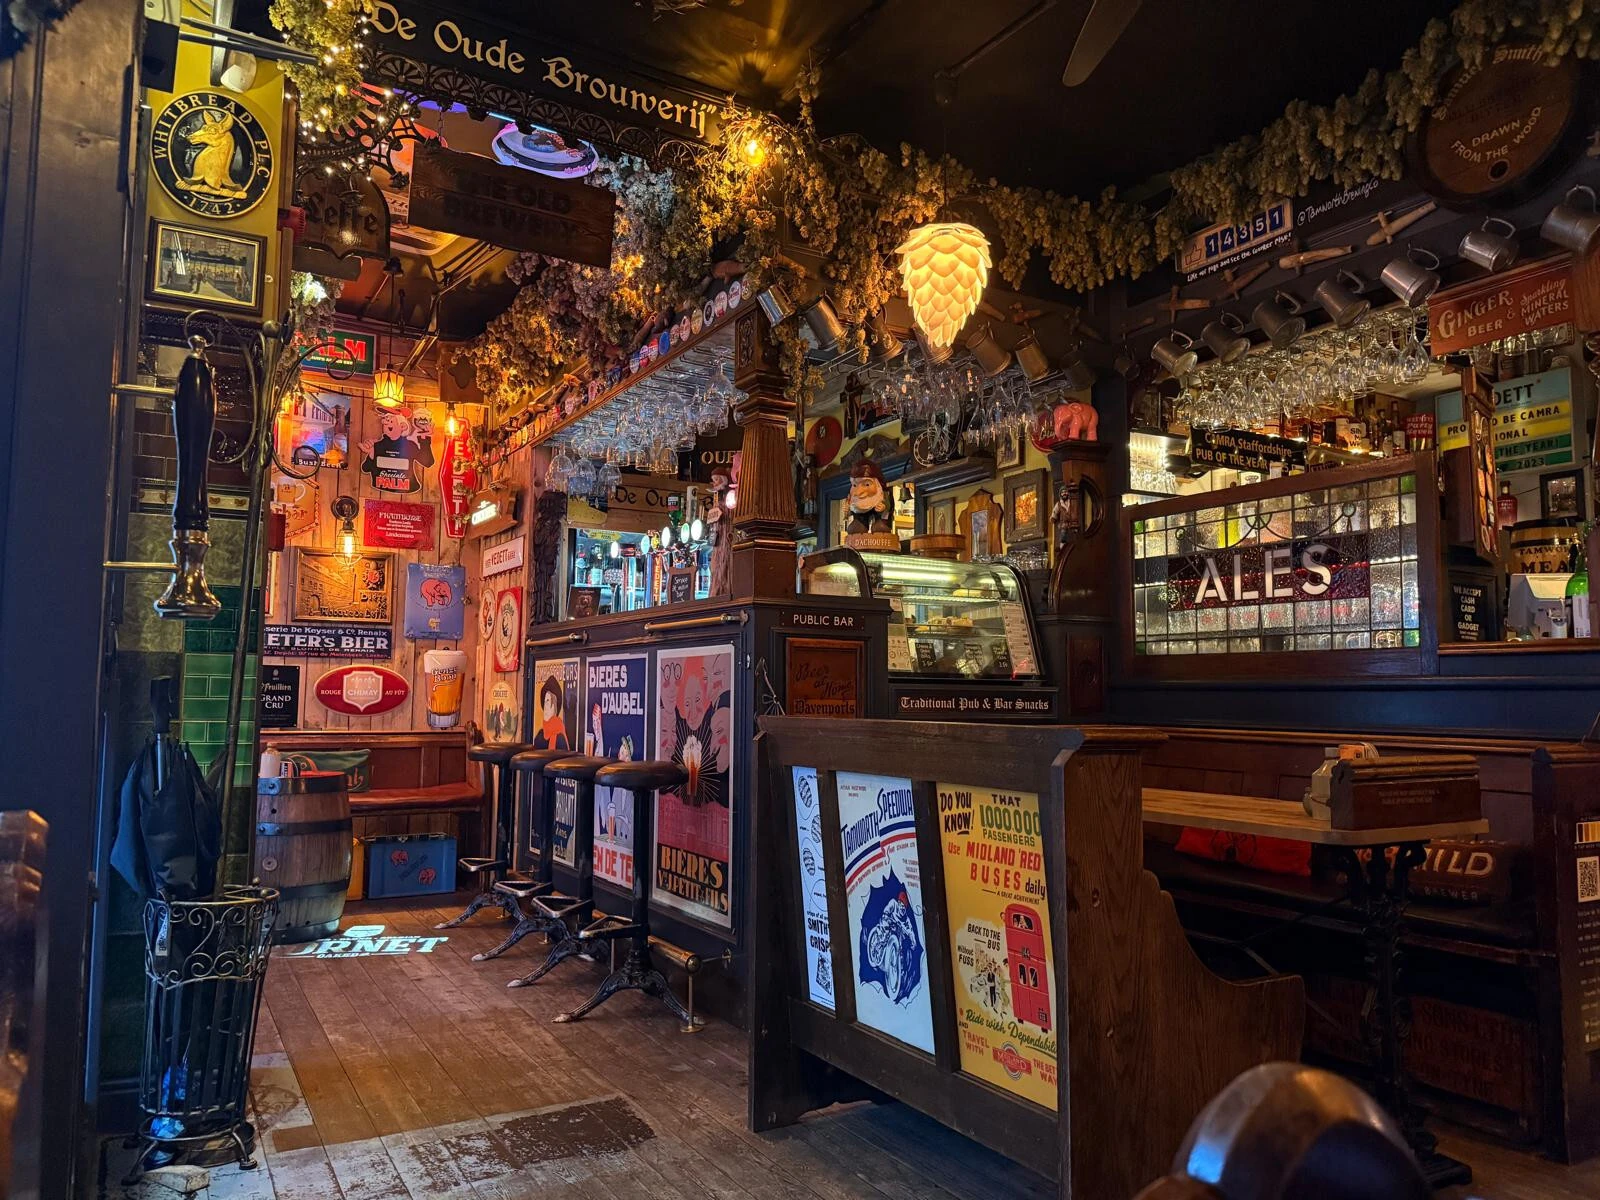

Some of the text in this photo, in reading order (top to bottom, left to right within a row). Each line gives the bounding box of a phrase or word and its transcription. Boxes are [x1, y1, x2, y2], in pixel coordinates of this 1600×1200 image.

[366, 1, 417, 41] De
[433, 20, 526, 74] Oude
[1492, 43, 1544, 65] Smith
[1471, 119, 1521, 148] DRAWN
[1513, 106, 1542, 145] WOOD
[153, 94, 270, 179] WHITBREAD PLC
[1450, 140, 1509, 163] FROM THE
[189, 197, 235, 215] 1742
[1521, 289, 1569, 317] MINERAL
[1437, 290, 1514, 338] GINGER
[1524, 300, 1569, 327] WATERS
[1467, 318, 1503, 337] BEER
[1447, 405, 1560, 436] PRO BE CAMRA
[1495, 427, 1528, 441] IONAL
[1237, 438, 1292, 458] Staffordshire
[1498, 445, 1520, 457] THE
[1195, 448, 1268, 470] PUB OF THE YEAR
[1517, 456, 1545, 469] 2023
[376, 476, 410, 491] PALM
[614, 486, 637, 506] De
[491, 549, 508, 566] VEDETT
[1194, 544, 1334, 604] ALES
[1519, 561, 1569, 574] MEA
[1460, 595, 1475, 605] CASH
[1460, 604, 1476, 614] CARD
[793, 614, 854, 627] PUBLIC BAR
[1457, 622, 1479, 632] GADGET
[1464, 614, 1473, 622] OR
[305, 627, 336, 636] Keyser
[357, 629, 388, 637] Renaix
[265, 633, 389, 650] ETER'S BIER
[589, 664, 628, 688] BIERES
[347, 689, 379, 697] CHIMAY
[265, 701, 284, 709] CRU
[601, 691, 644, 715] D'AUBEL
[794, 697, 856, 715] Davenports
[901, 696, 1049, 712] Traditional Pub & Bar Snacks
[877, 787, 914, 823] SPEEDWA
[940, 791, 972, 814] DO YOU
[991, 793, 1021, 808] THAT
[944, 809, 975, 834] KNOW!
[841, 810, 881, 861] TAMWORTH
[982, 828, 1035, 847] PASSENGERS
[605, 849, 617, 877] DE
[948, 841, 960, 856] Use
[966, 841, 1016, 867] MIDLAND
[970, 862, 1046, 901] BUSES daily
[1014, 893, 1040, 906] ACHIEVEMENT
[967, 923, 1001, 941] BACK TO THE
[810, 935, 830, 953] CRISP
[987, 939, 1001, 951] BUS
[958, 953, 974, 968] FUSS
[958, 1021, 969, 1030] AND
[965, 1009, 986, 1027] Ride
[986, 1019, 1007, 1035] with
[962, 1029, 990, 1049] TRAVEL
[965, 1041, 984, 1057] WITH
[1044, 1062, 1057, 1075] BET
